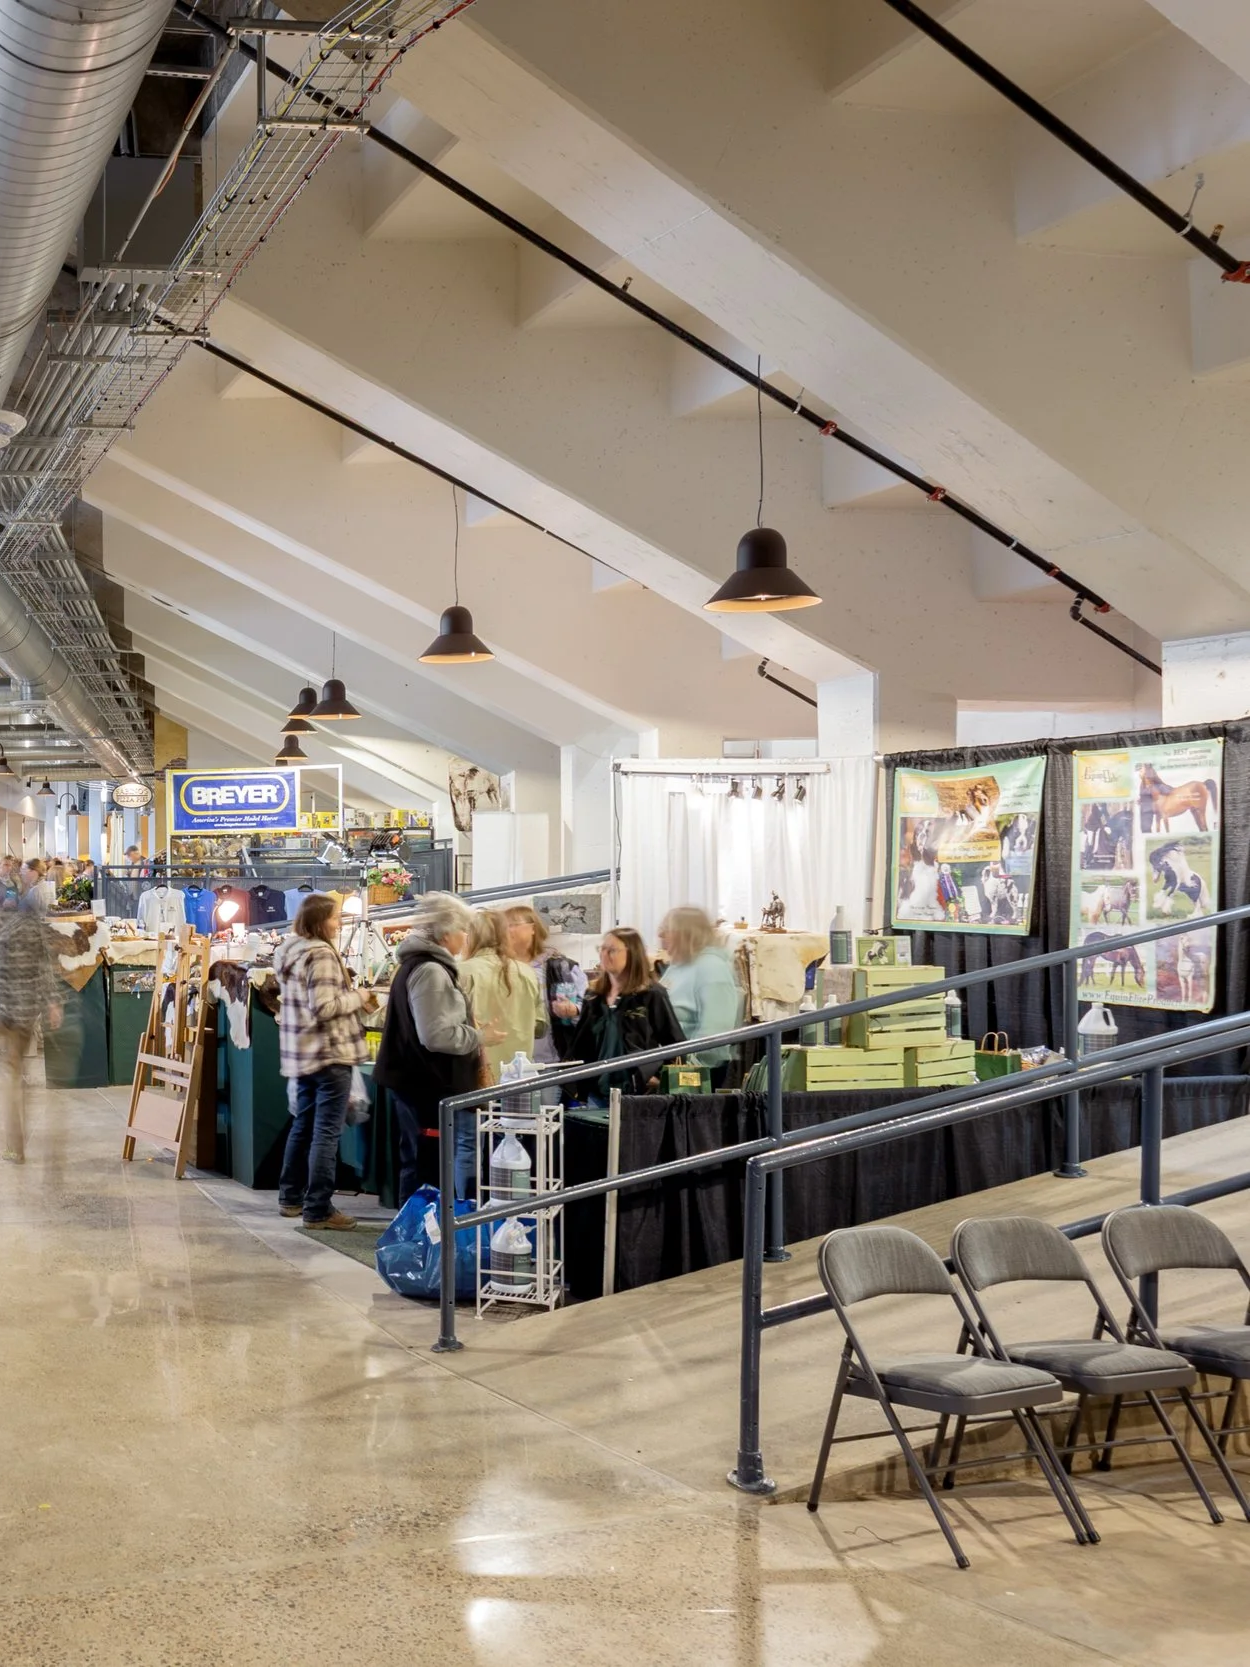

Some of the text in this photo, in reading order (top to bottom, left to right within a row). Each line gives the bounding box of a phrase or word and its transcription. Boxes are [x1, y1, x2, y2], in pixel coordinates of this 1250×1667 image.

[192, 785, 278, 806] BREYER
[191, 816, 219, 824] America's
[220, 815, 243, 823] Premier
[244, 814, 261, 822] Model
